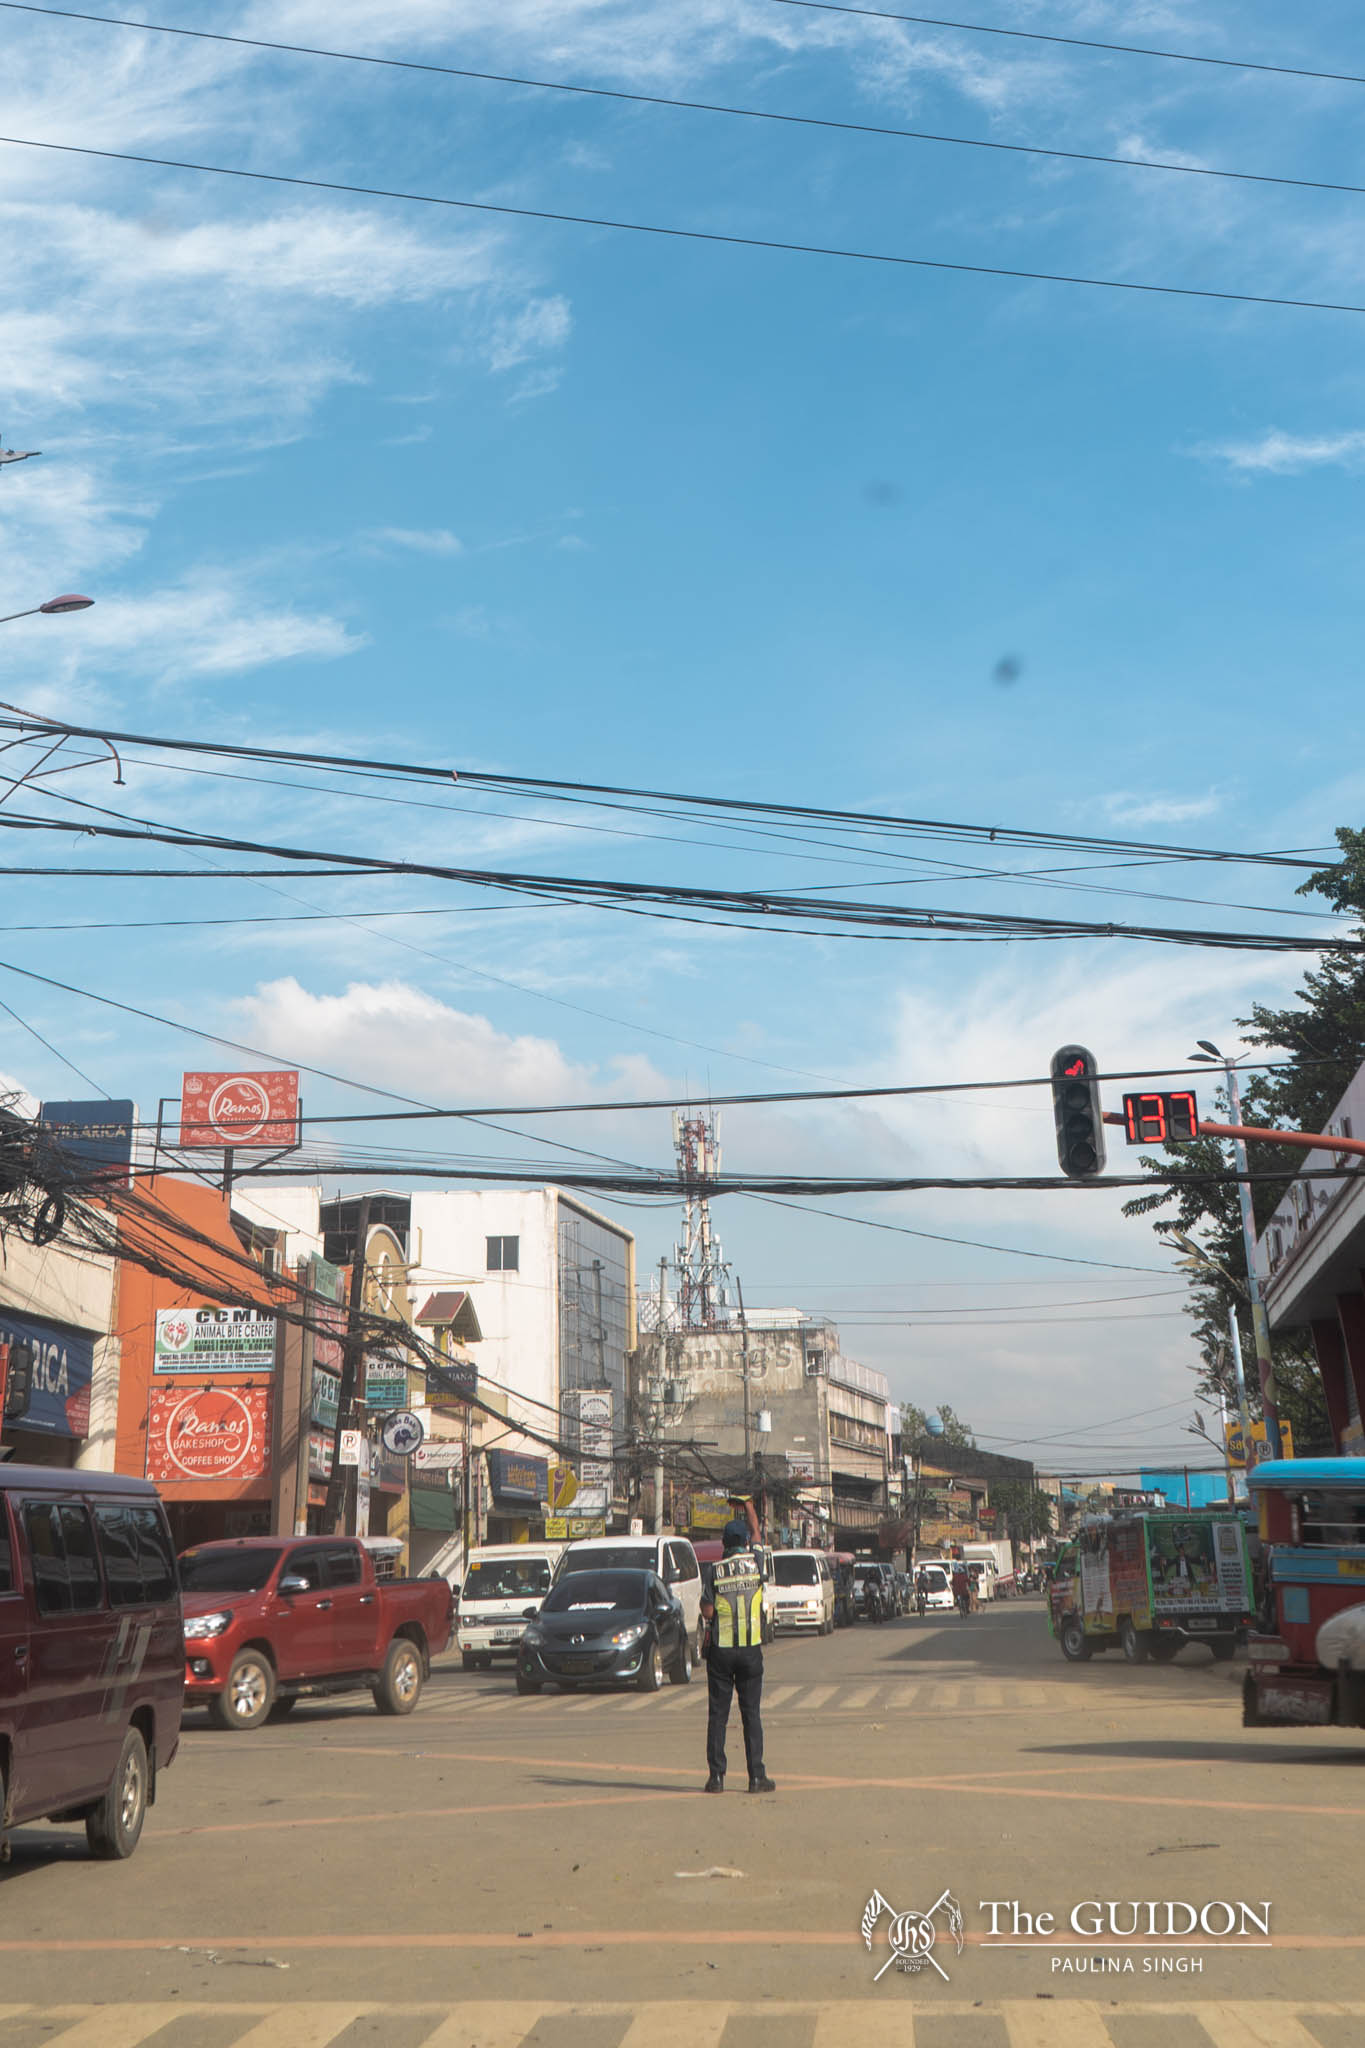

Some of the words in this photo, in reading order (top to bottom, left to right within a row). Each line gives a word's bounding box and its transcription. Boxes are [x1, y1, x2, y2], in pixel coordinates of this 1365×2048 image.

[216, 1096, 262, 1118] Ramos
[1127, 1093, 1197, 1142] 137
[195, 1310, 274, 1323] CCMM
[194, 1326, 226, 1338] ANIMAL
[227, 1325, 243, 1337] BITE
[244, 1324, 273, 1337] CENTER
[177, 1414, 247, 1441] Ramos
[173, 1438, 225, 1450] BAKESHOP
[181, 1456, 213, 1466] COFFEE
[213, 1455, 236, 1465] SHOP
